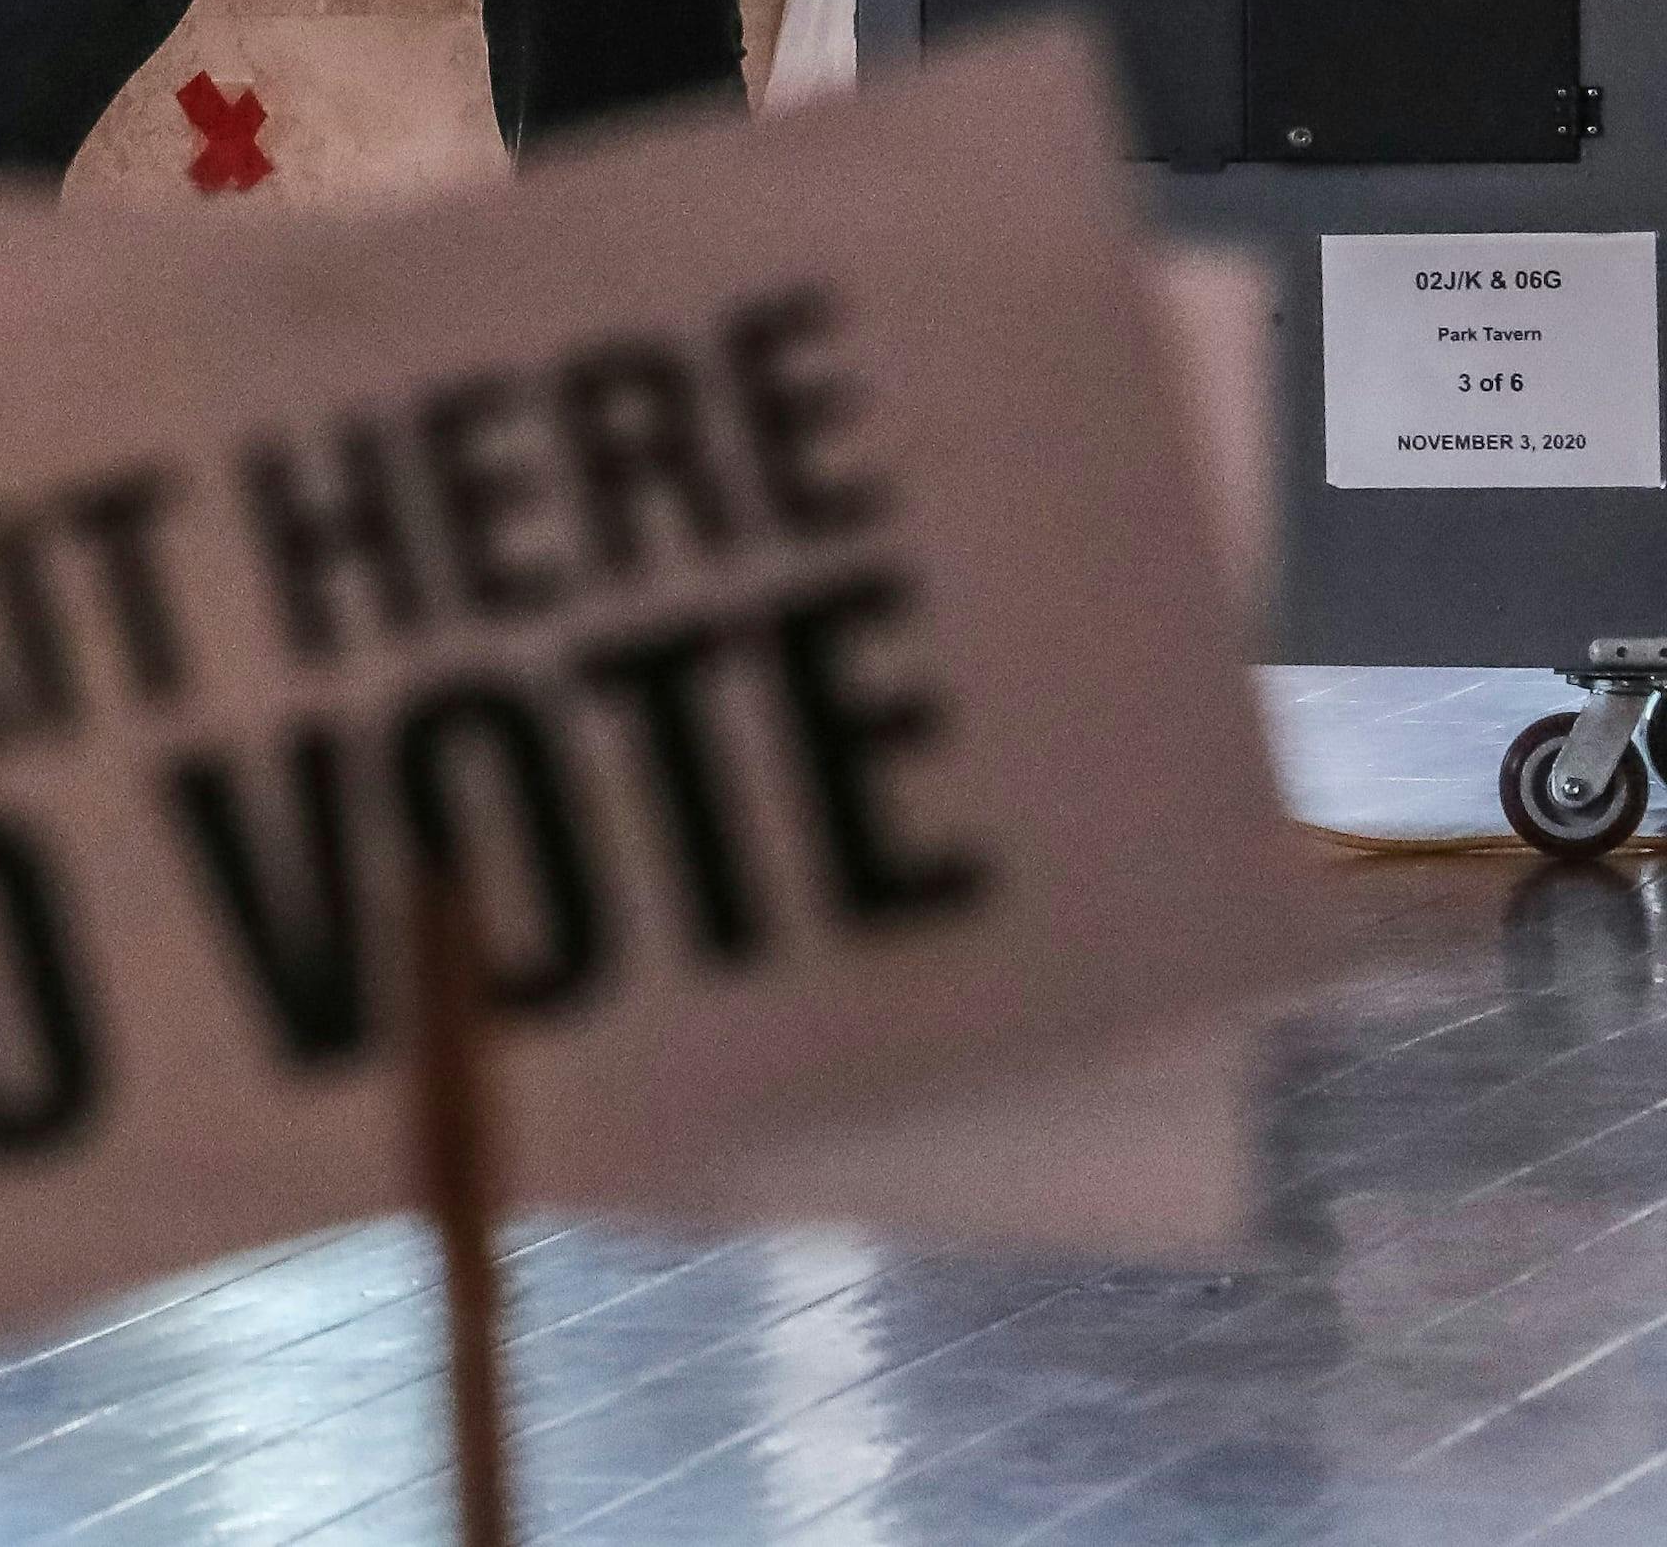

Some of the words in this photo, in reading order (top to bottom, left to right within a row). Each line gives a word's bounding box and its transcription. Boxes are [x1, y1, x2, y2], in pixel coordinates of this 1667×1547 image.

[1416, 271, 1483, 291] 02J/K
[1490, 271, 1508, 291] &
[1515, 270, 1563, 290] 06G
[1437, 326, 1478, 342] Park
[1482, 326, 1543, 342] Tavern
[1457, 373, 1472, 393] 3
[1479, 372, 1504, 393] of
[1510, 373, 1524, 392] 6
[1397, 434, 1514, 451] NOVEMBER
[1520, 434, 1537, 453] 3,
[1542, 434, 1587, 450] 2020
[247, 281, 892, 663] HERE
[157, 558, 992, 1078] VOTE
